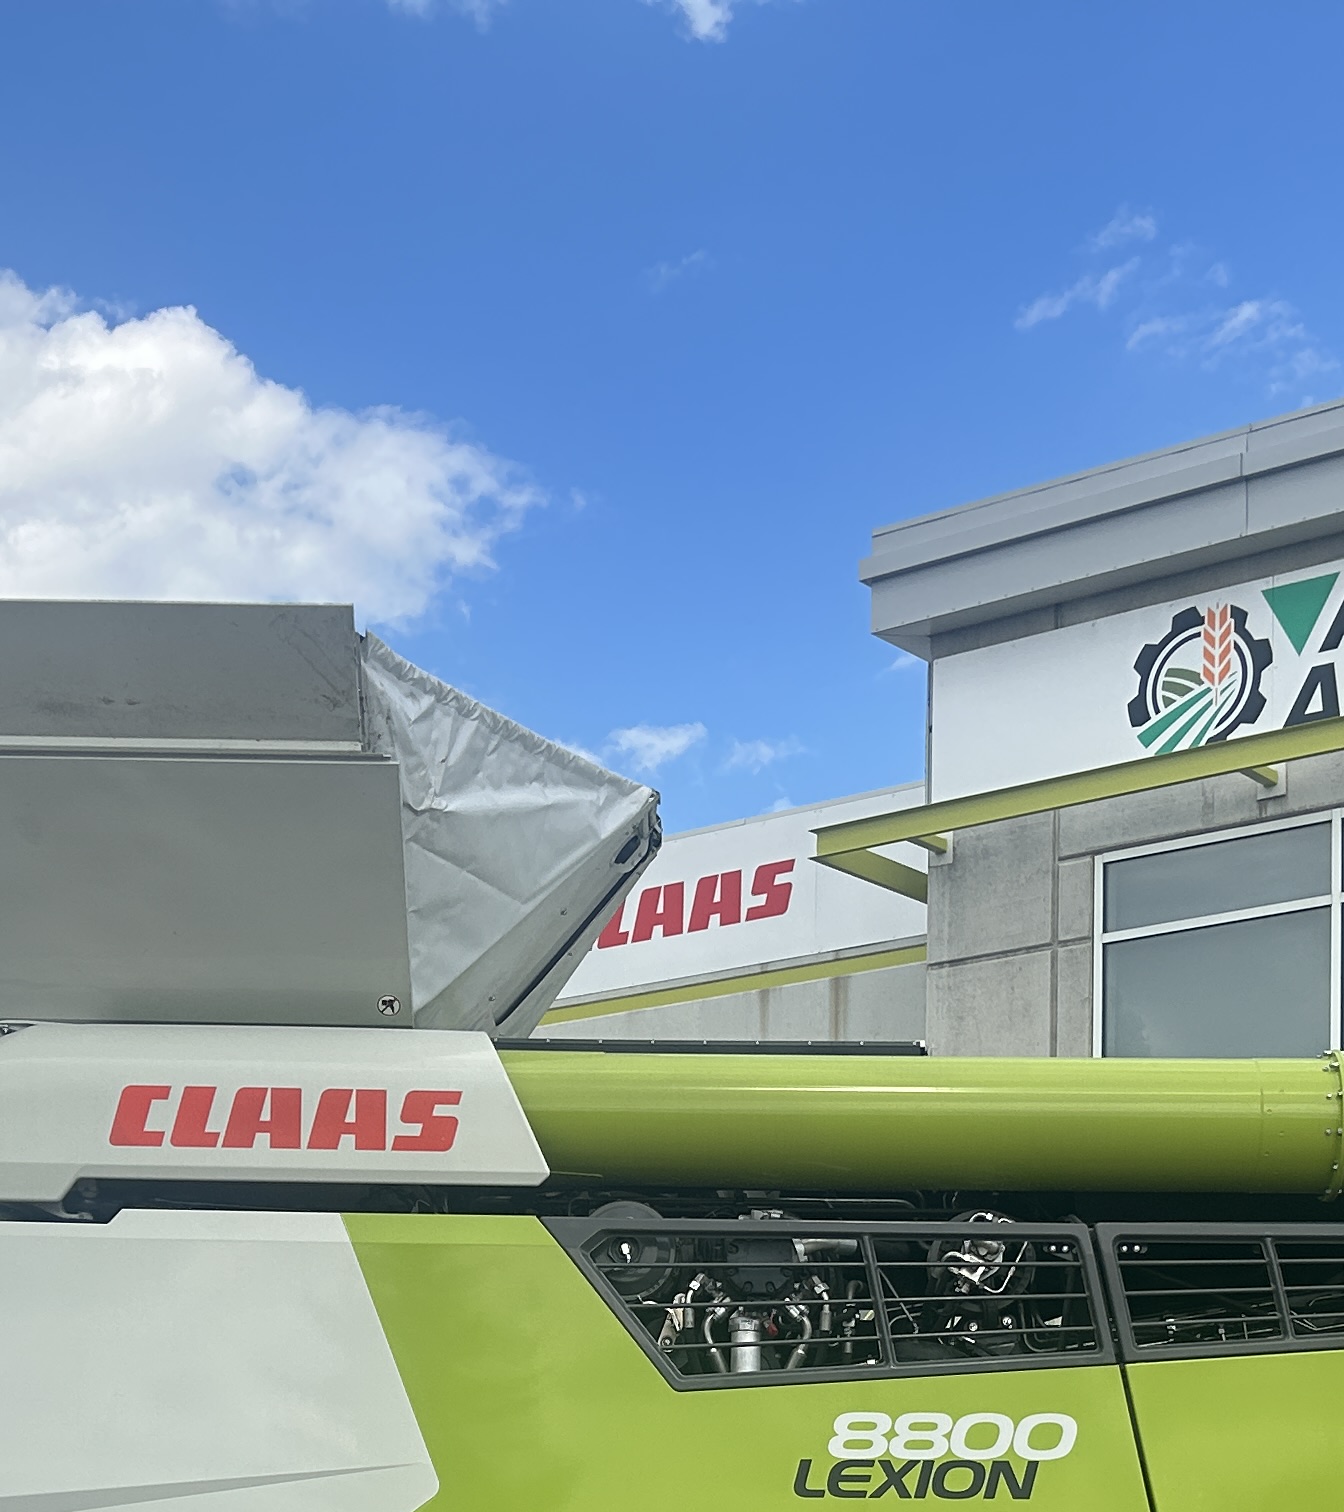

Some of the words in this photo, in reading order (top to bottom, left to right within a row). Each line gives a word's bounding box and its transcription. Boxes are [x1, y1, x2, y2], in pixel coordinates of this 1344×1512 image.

[596, 858, 796, 950] LAAS
[109, 1084, 464, 1153] CLAAS
[827, 1411, 1078, 1461] 8800
[793, 1458, 1040, 1500] LEXION
